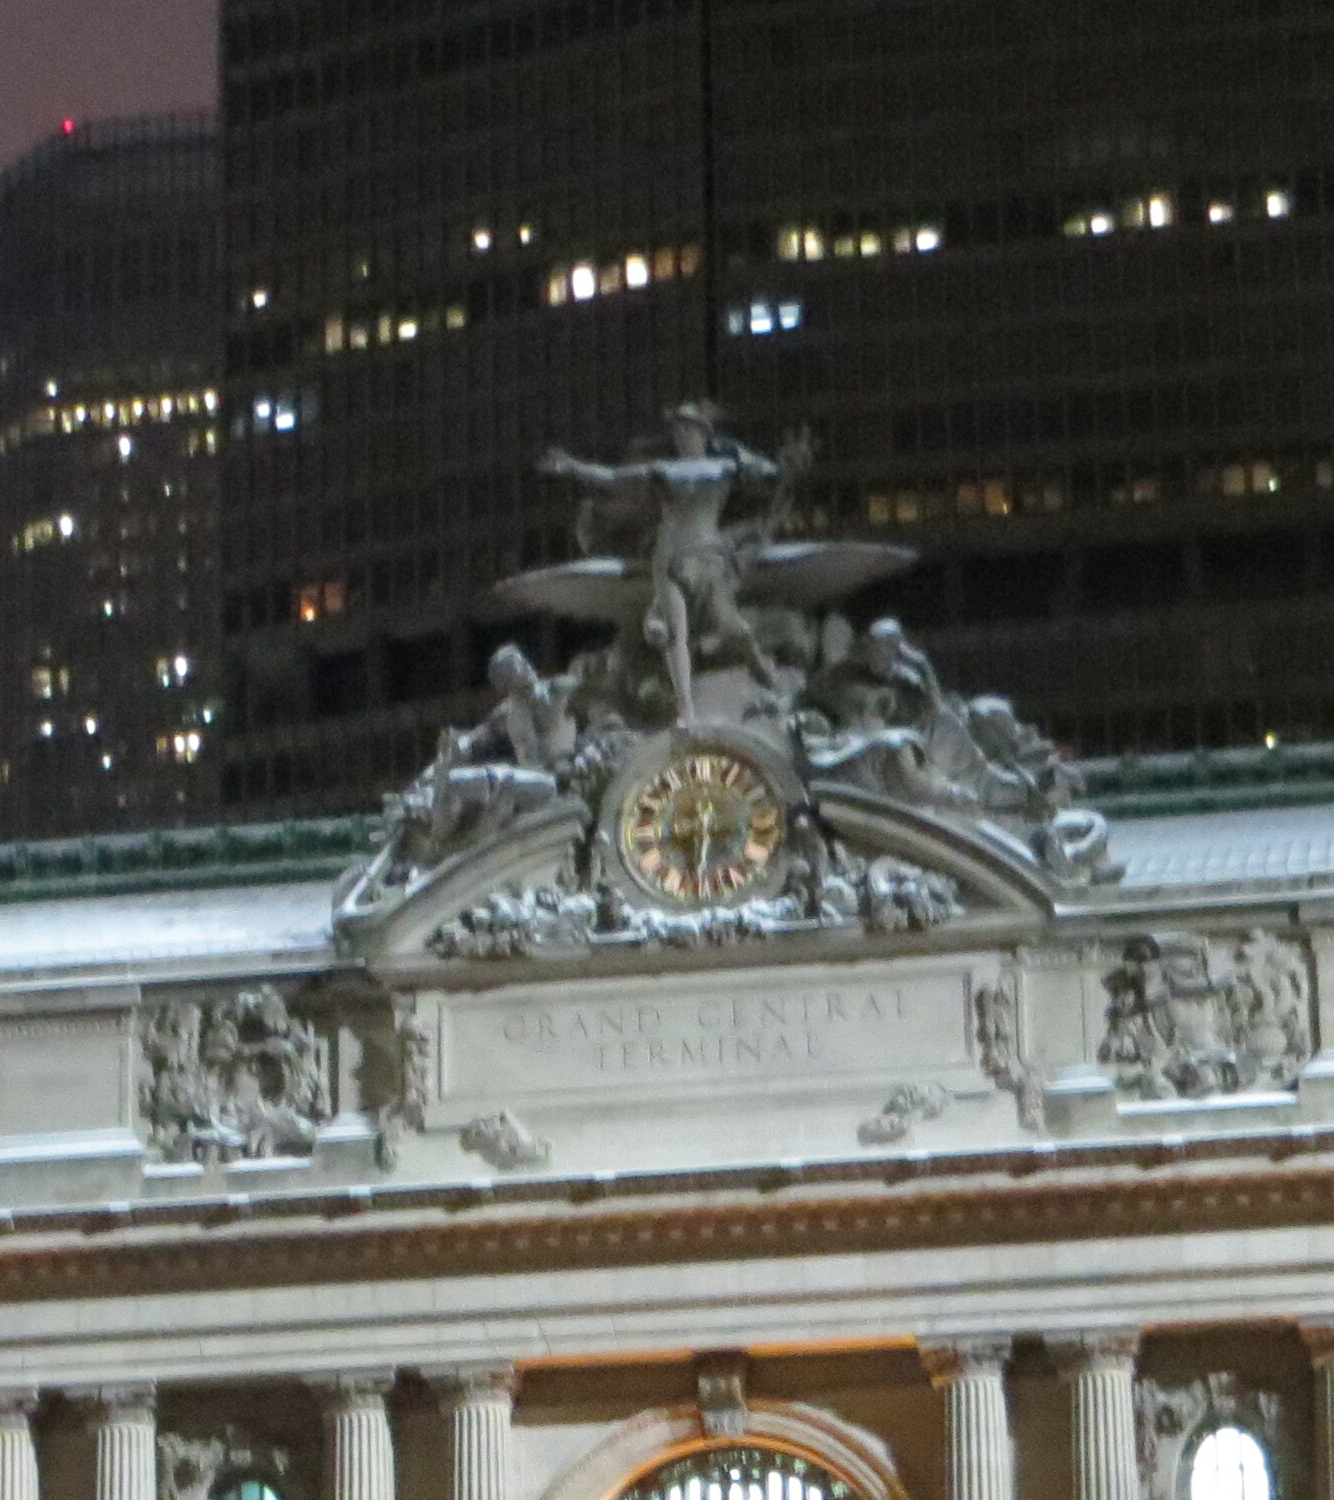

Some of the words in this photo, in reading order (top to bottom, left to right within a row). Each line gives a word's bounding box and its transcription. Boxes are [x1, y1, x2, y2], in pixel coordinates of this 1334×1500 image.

[501, 1004, 662, 1041] GRAND
[696, 989, 907, 1029] CENTRAL
[596, 1035, 820, 1071] TERMINAL
